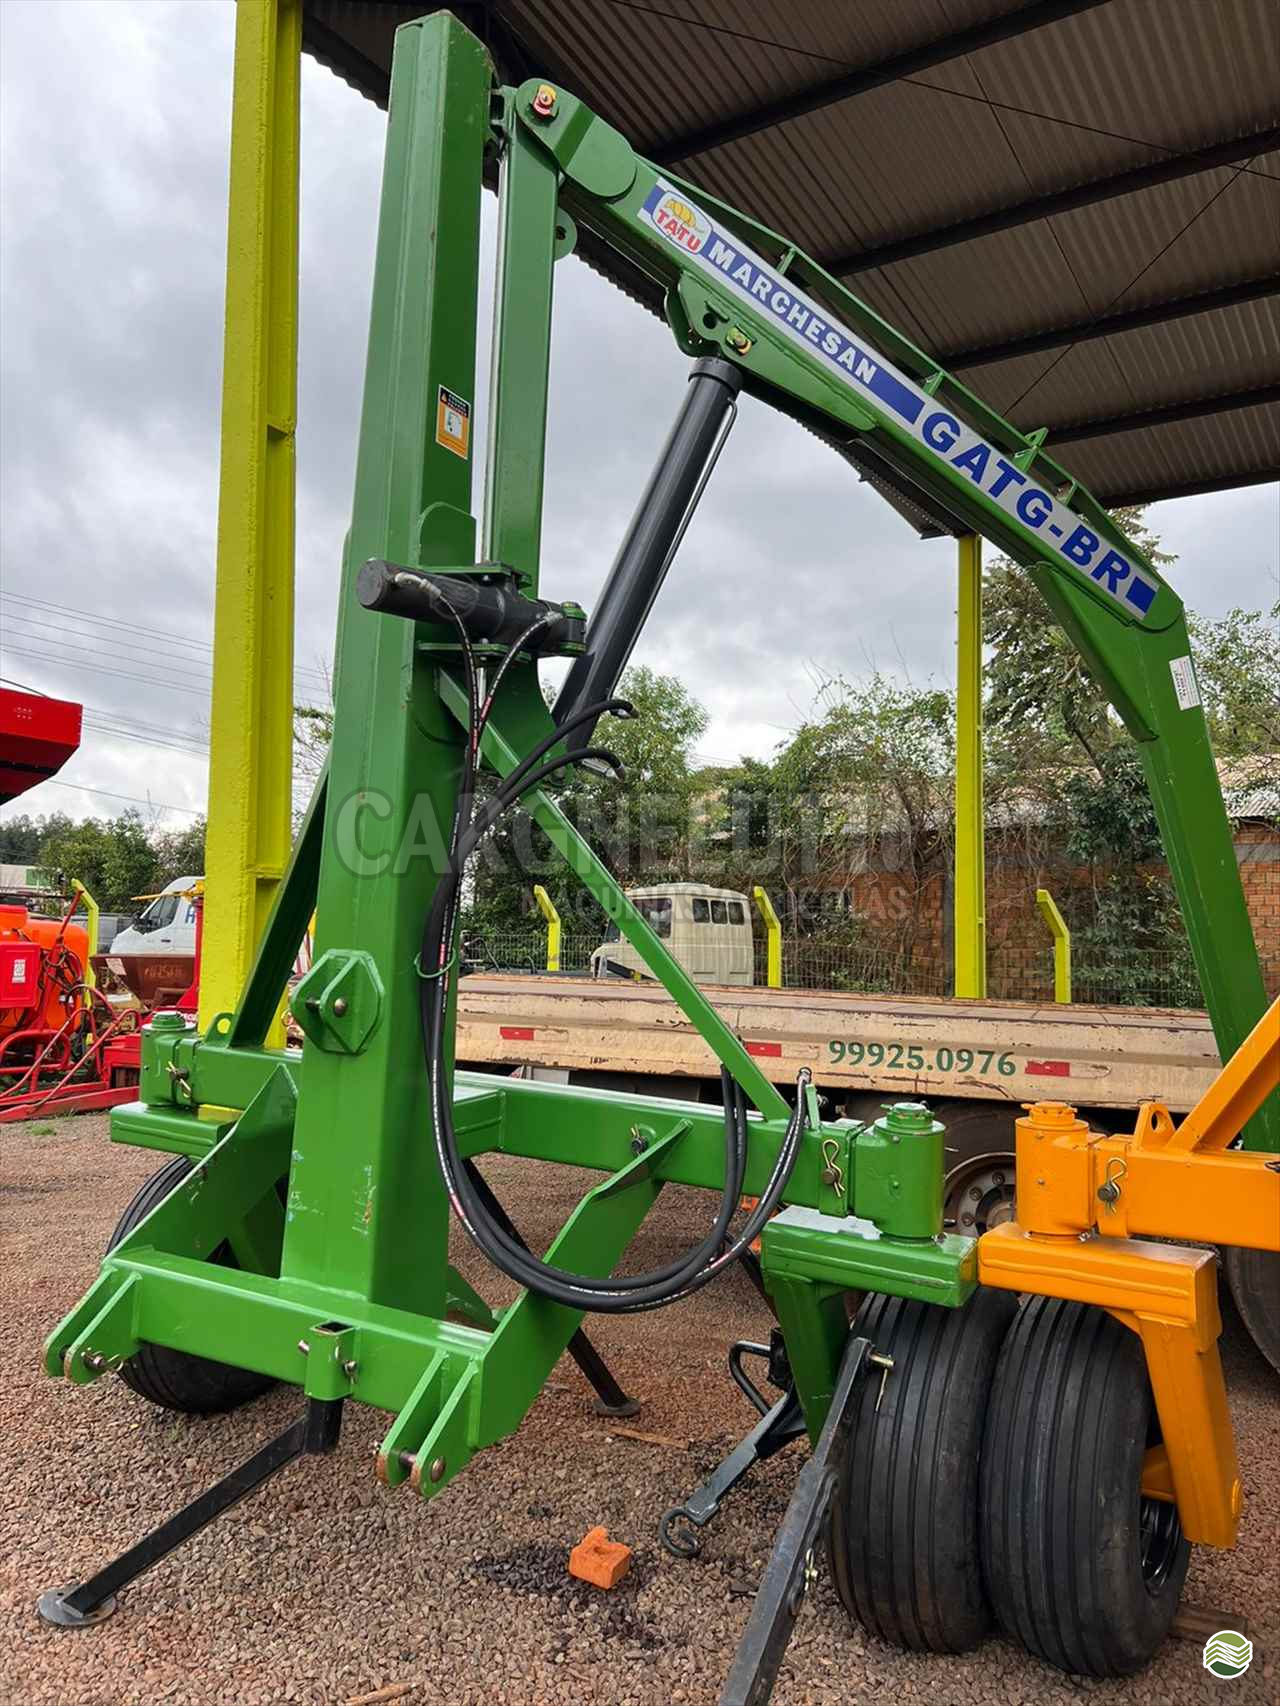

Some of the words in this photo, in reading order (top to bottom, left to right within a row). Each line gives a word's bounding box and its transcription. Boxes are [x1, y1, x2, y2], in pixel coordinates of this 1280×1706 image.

[656, 209, 702, 252] TATU
[708, 240, 877, 384] MARCHESAN
[922, 412, 1131, 595] GATG-BR
[828, 1040, 1017, 1076] 99925.0976
